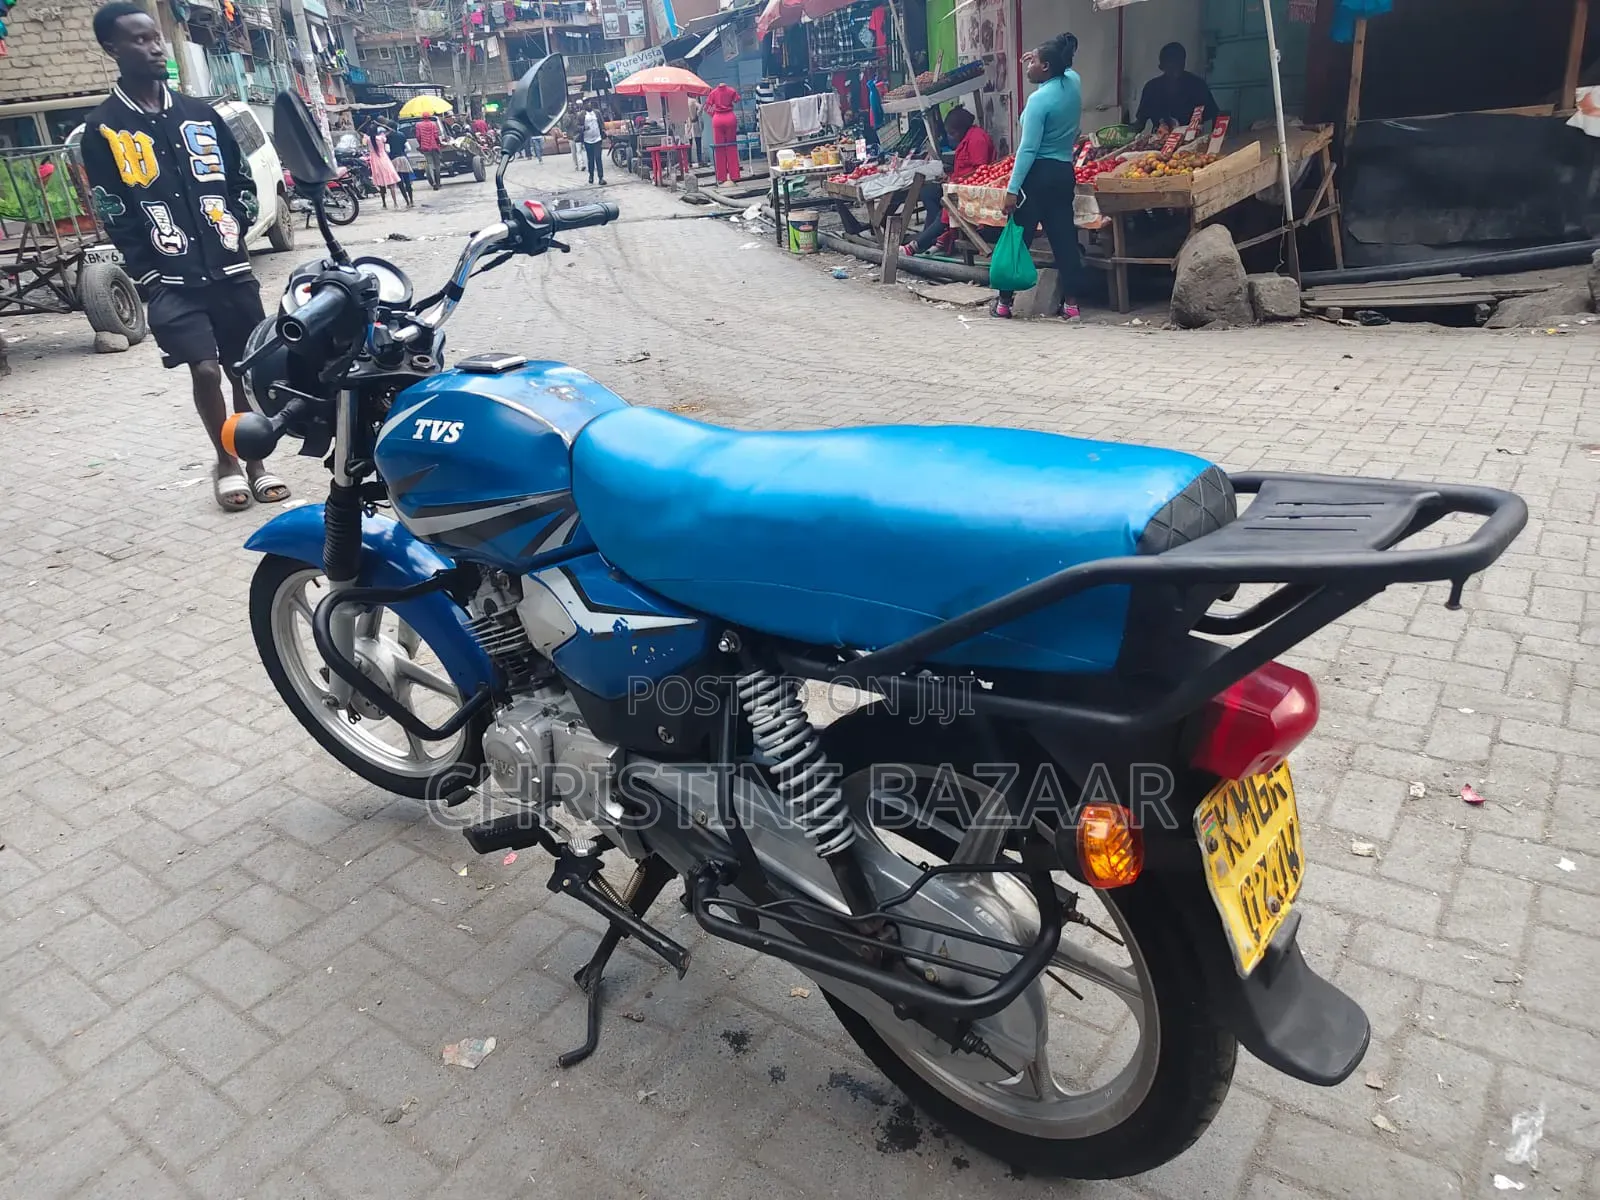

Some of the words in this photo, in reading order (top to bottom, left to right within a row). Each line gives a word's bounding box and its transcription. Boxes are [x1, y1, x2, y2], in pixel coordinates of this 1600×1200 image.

[615, 48, 662, 69] PureVista
[179, 120, 226, 183] S
[412, 418, 465, 443] TVS
